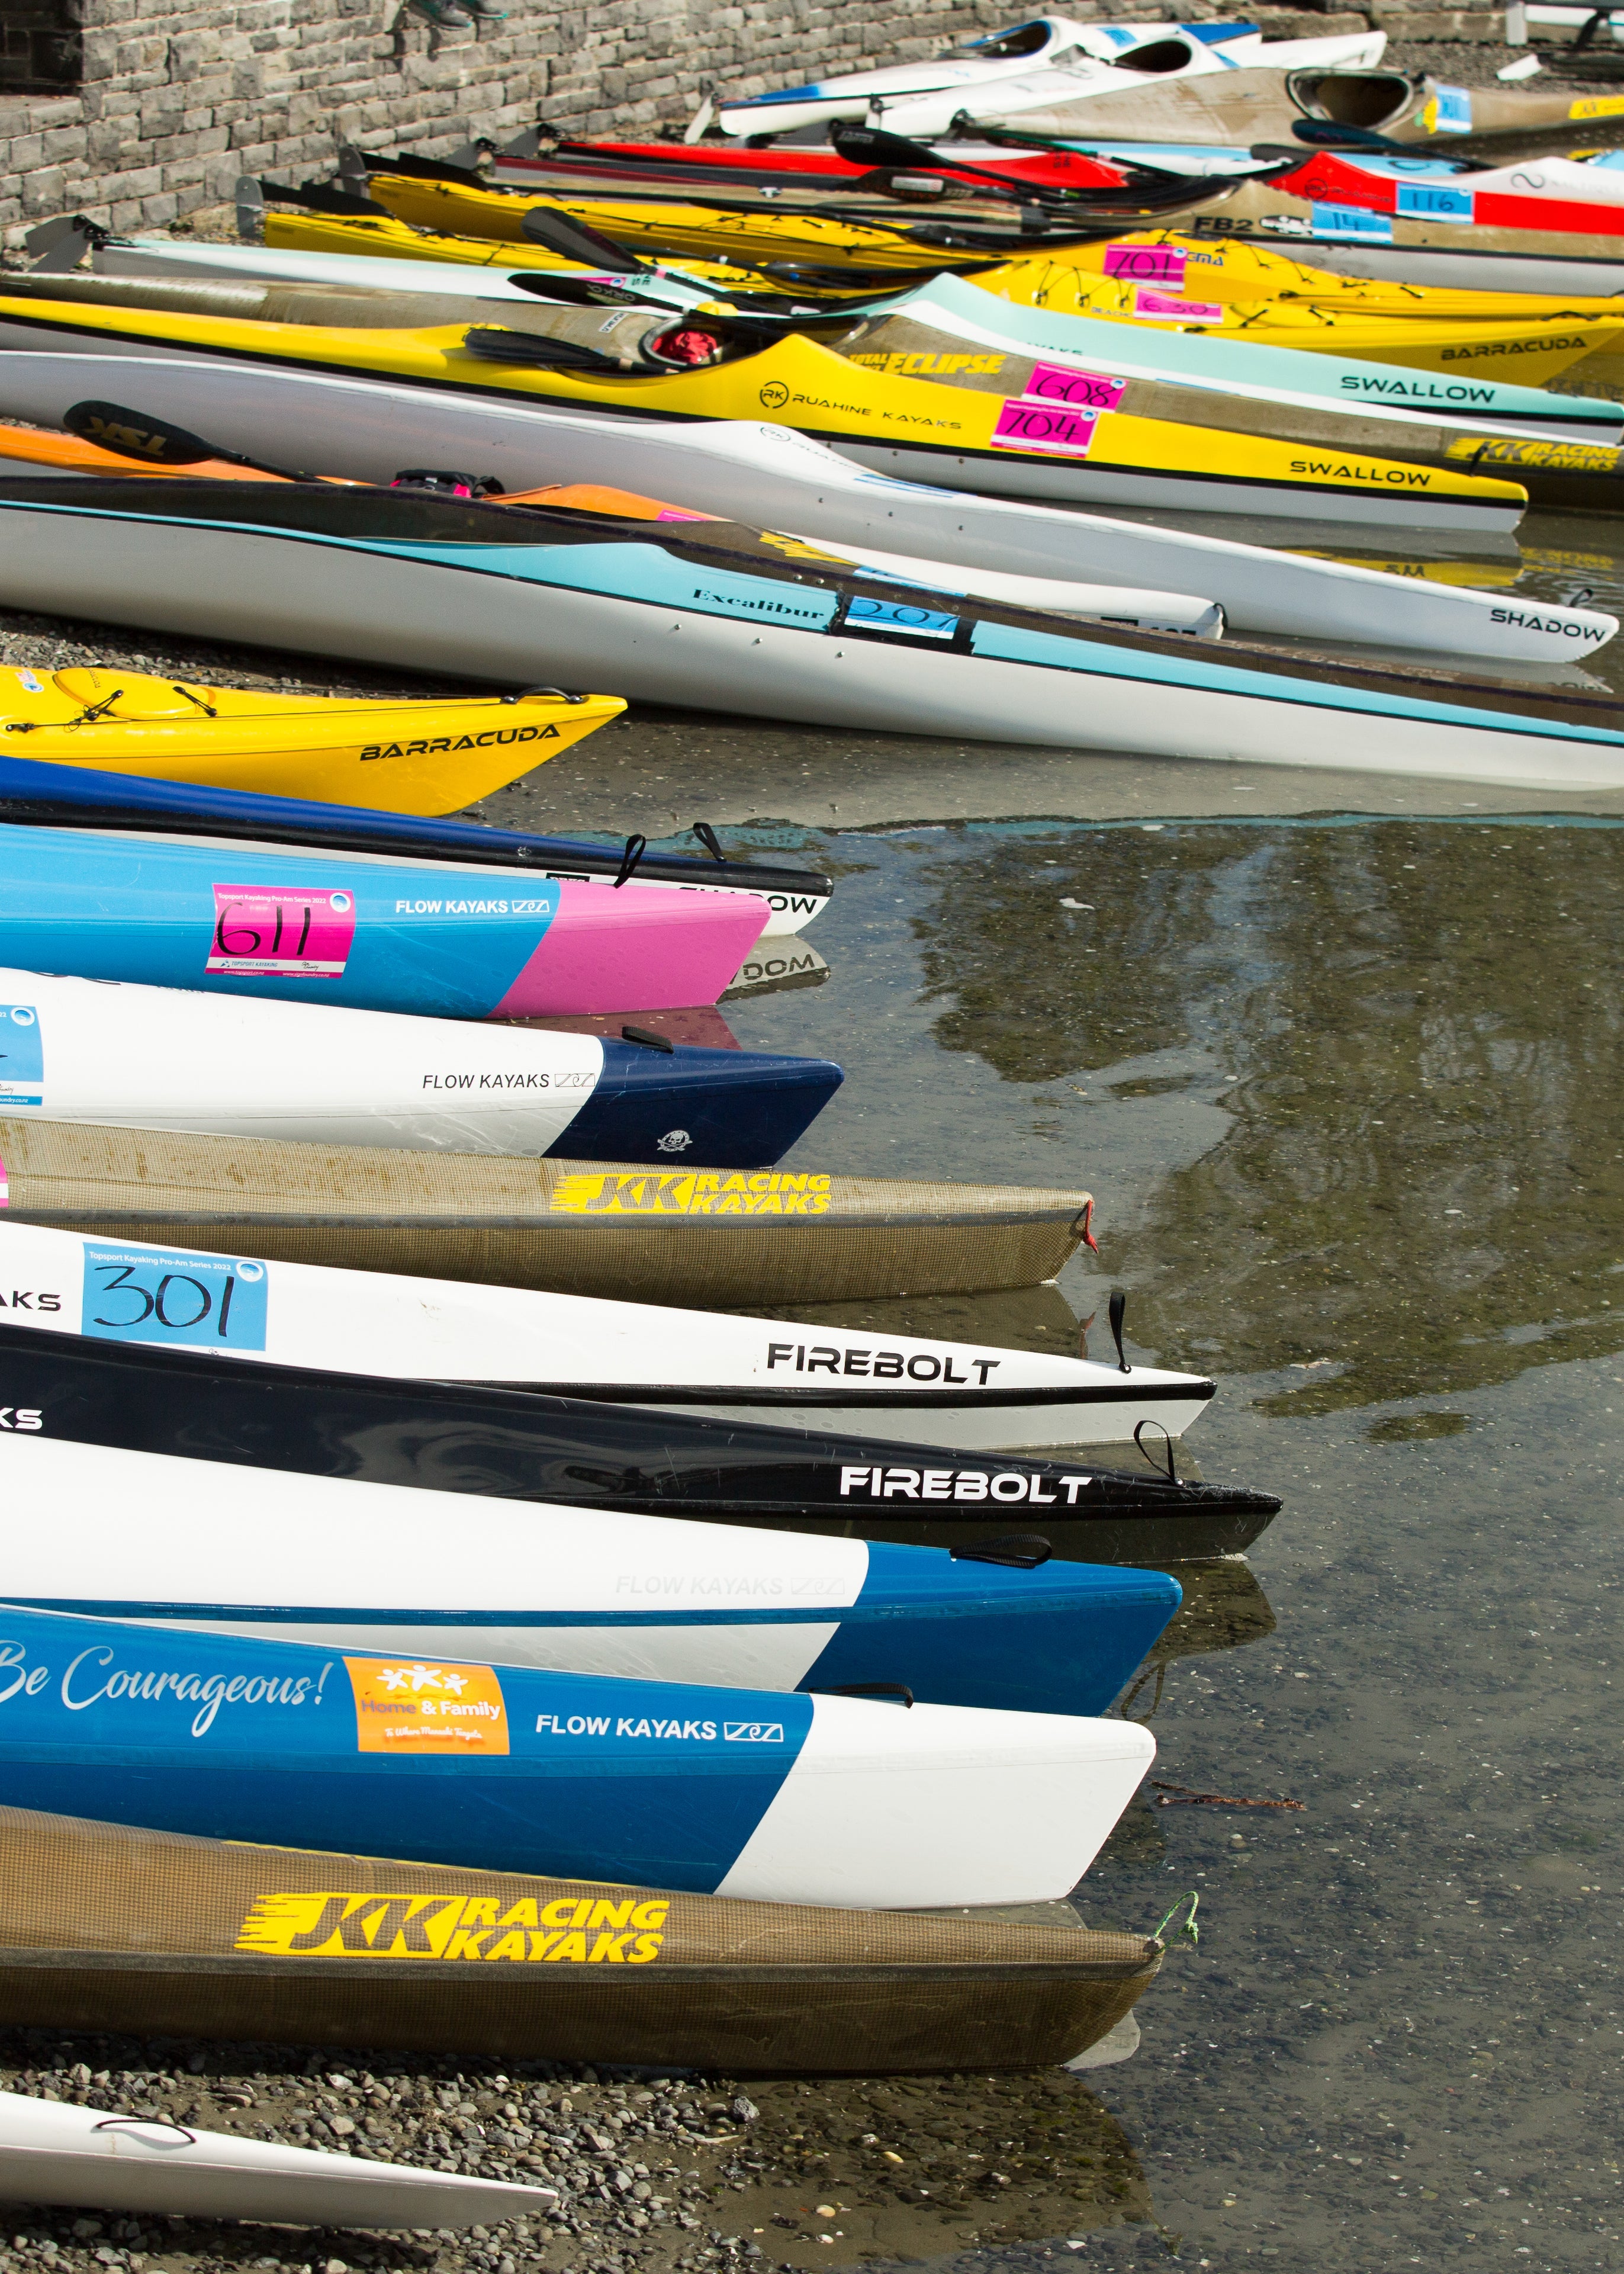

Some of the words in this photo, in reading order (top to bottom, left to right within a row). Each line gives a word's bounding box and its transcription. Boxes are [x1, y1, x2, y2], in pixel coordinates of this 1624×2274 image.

[1412, 193, 1455, 211] 116
[1194, 216, 1253, 232] FB2
[1333, 212, 1370, 231] 14
[1108, 251, 1171, 279] 701
[1186, 252, 1224, 266] GMA
[1440, 336, 1587, 361] BARRACUDA
[883, 352, 1006, 375] ECLIPSE
[1036, 374, 1117, 406] 608
[1340, 375, 1496, 403] SWALLOW
[792, 393, 872, 416] RUAHINE
[882, 412, 962, 430] KAYAKS
[1005, 409, 1079, 441] 704
[1527, 454, 1617, 472] KAYAKS
[1535, 444, 1622, 459] RACING
[1291, 461, 1431, 486] SWALLOW
[692, 589, 825, 619] Excalibur
[1490, 608, 1606, 643] SHADOW
[359, 724, 561, 762] BARRACUDA
[218, 892, 244, 901] Topsport
[245, 894, 271, 902] Kayaking
[395, 900, 443, 914] FLOW
[445, 900, 508, 914] KAYAKS
[217, 902, 311, 956] 611
[422, 1074, 475, 1088] FLOW
[479, 1074, 549, 1088] KAYAKS
[695, 1174, 831, 1193] RACING
[689, 1194, 832, 1215] KAYAKS
[89, 1251, 123, 1263] Topsport
[124, 1254, 159, 1266] Kayaking
[160, 1257, 188, 1267] Pro-Am
[189, 1261, 212, 1269] Series
[92, 1265, 235, 1338] 301
[767, 1342, 1001, 1386] FIREBOLT
[840, 1466, 1093, 1504] FIREBOLT
[615, 1575, 685, 1595] FLOW
[690, 1576, 784, 1595] KAYAKS
[0, 1639, 53, 1704] Be
[61, 1645, 335, 1738] Courageous!
[361, 1699, 417, 1714] Home
[421, 1700, 437, 1716] &
[439, 1700, 501, 1721] Family
[535, 1714, 612, 1736] FLOW
[615, 1717, 718, 1740] KAYAKS
[459, 1896, 671, 1929] RACING
[442, 1929, 664, 1964] KAYAKS
